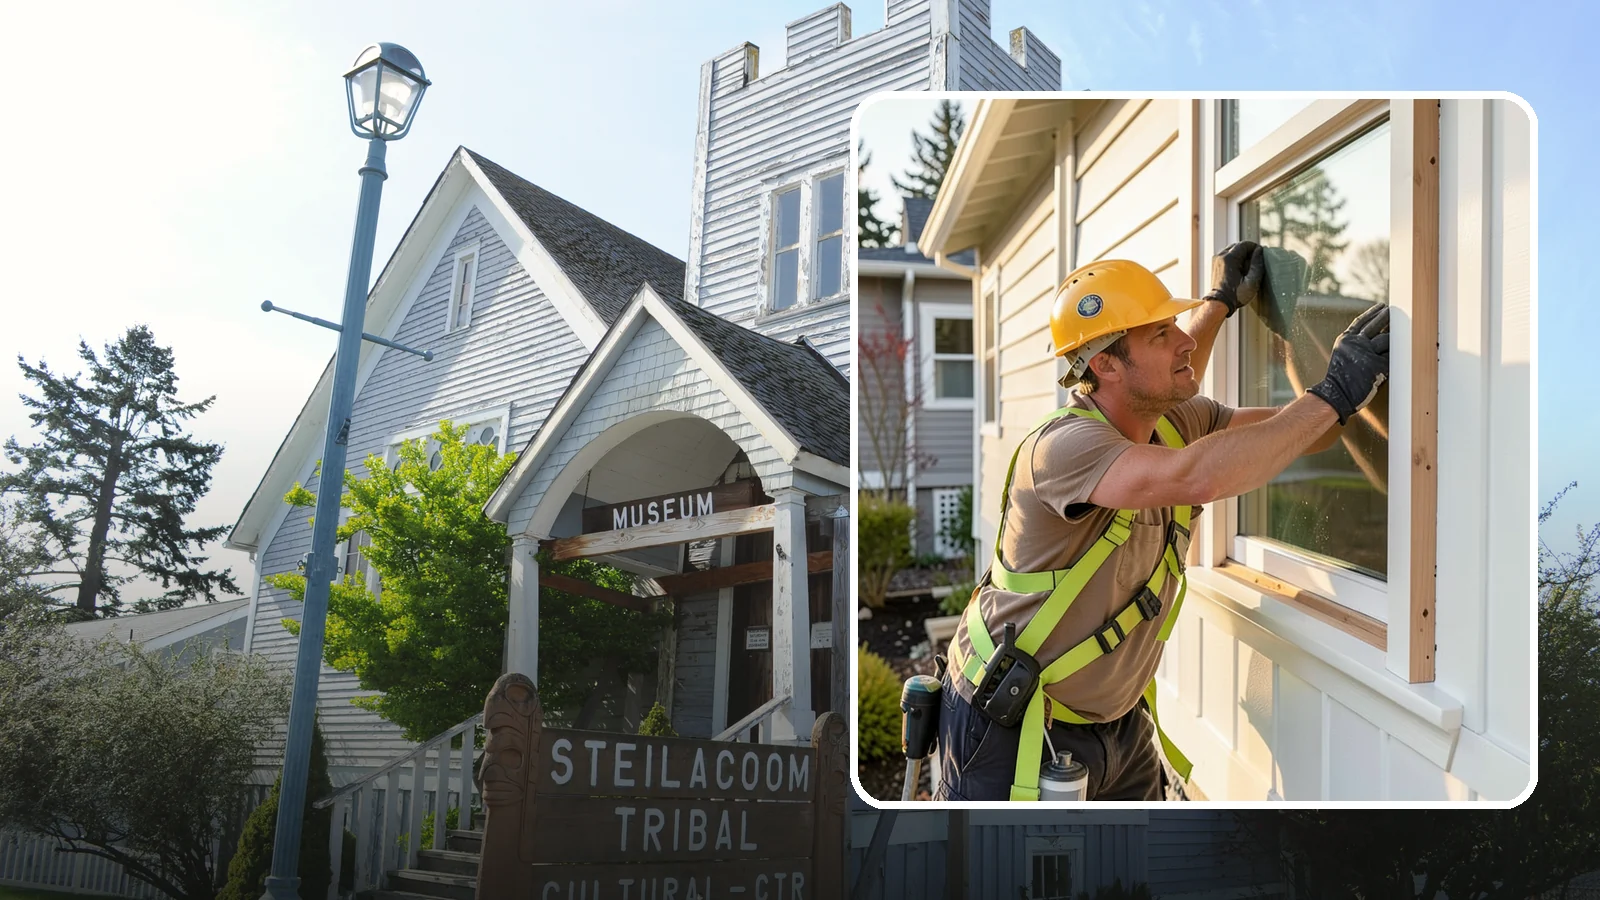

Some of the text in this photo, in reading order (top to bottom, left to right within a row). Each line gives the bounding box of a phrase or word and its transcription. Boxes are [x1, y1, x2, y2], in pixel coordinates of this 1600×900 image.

[613, 492, 713, 530] MUSEUM
[551, 738, 809, 792] STEILACOOM
[615, 807, 757, 851] TRIBAL
